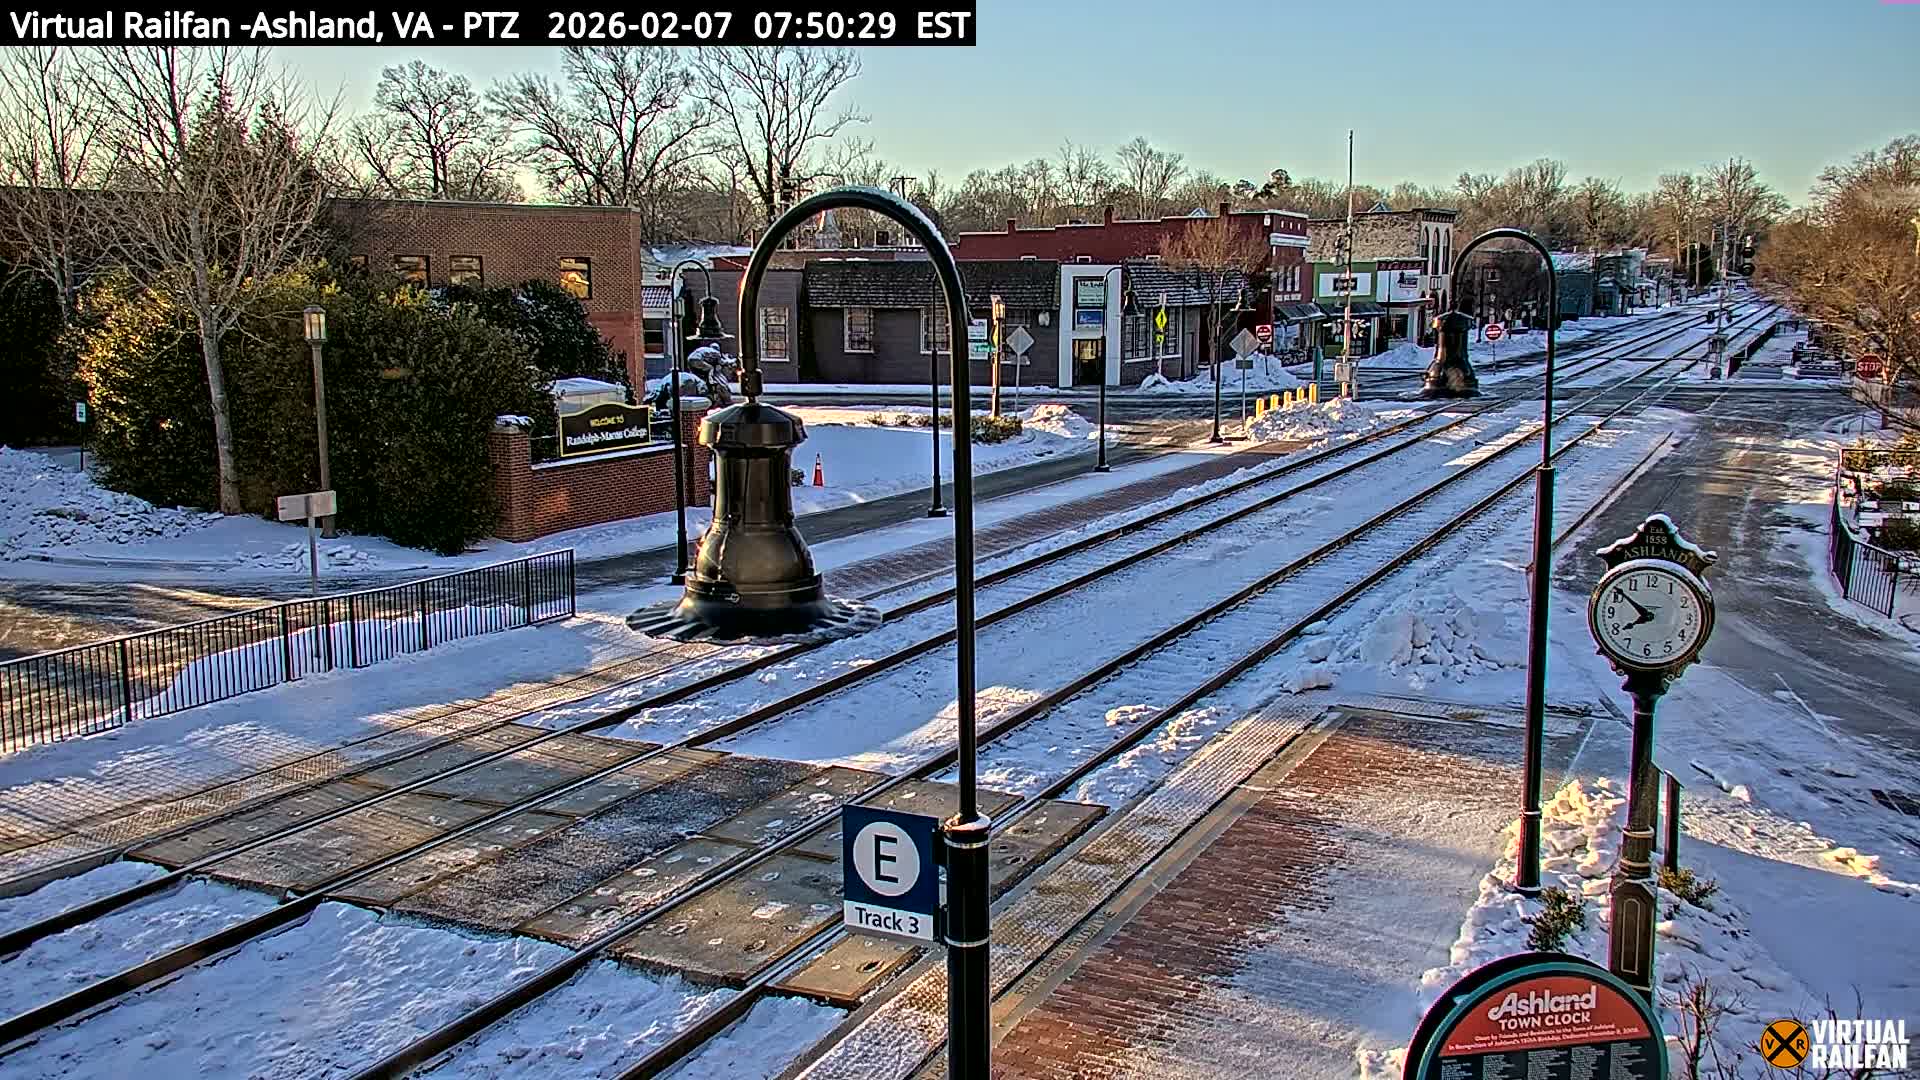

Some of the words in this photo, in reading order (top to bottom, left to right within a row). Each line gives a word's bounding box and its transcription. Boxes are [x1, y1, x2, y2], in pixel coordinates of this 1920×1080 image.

[1857, 362, 1881, 371] STOP
[1623, 545, 1688, 563] ASHLAND
[1629, 577, 1638, 591] 11
[1646, 575, 1658, 588] 12
[1668, 582, 1674, 595] 1
[1612, 592, 1624, 604] 10
[1680, 596, 1688, 609] 2
[1607, 606, 1615, 619] 9
[1686, 614, 1694, 626] 3
[1611, 622, 1620, 636] 8
[1678, 628, 1686, 641] 4
[1623, 638, 1632, 650] 7
[1643, 643, 1652, 656] 6
[1663, 641, 1672, 654] 5
[874, 834, 899, 884] E
[854, 906, 903, 932] Track
[908, 915, 920, 934] 3
[1487, 985, 1598, 1022] Ashland
[1498, 1016, 1541, 1032] TOWN
[1544, 1011, 1592, 1026] CLOCK
